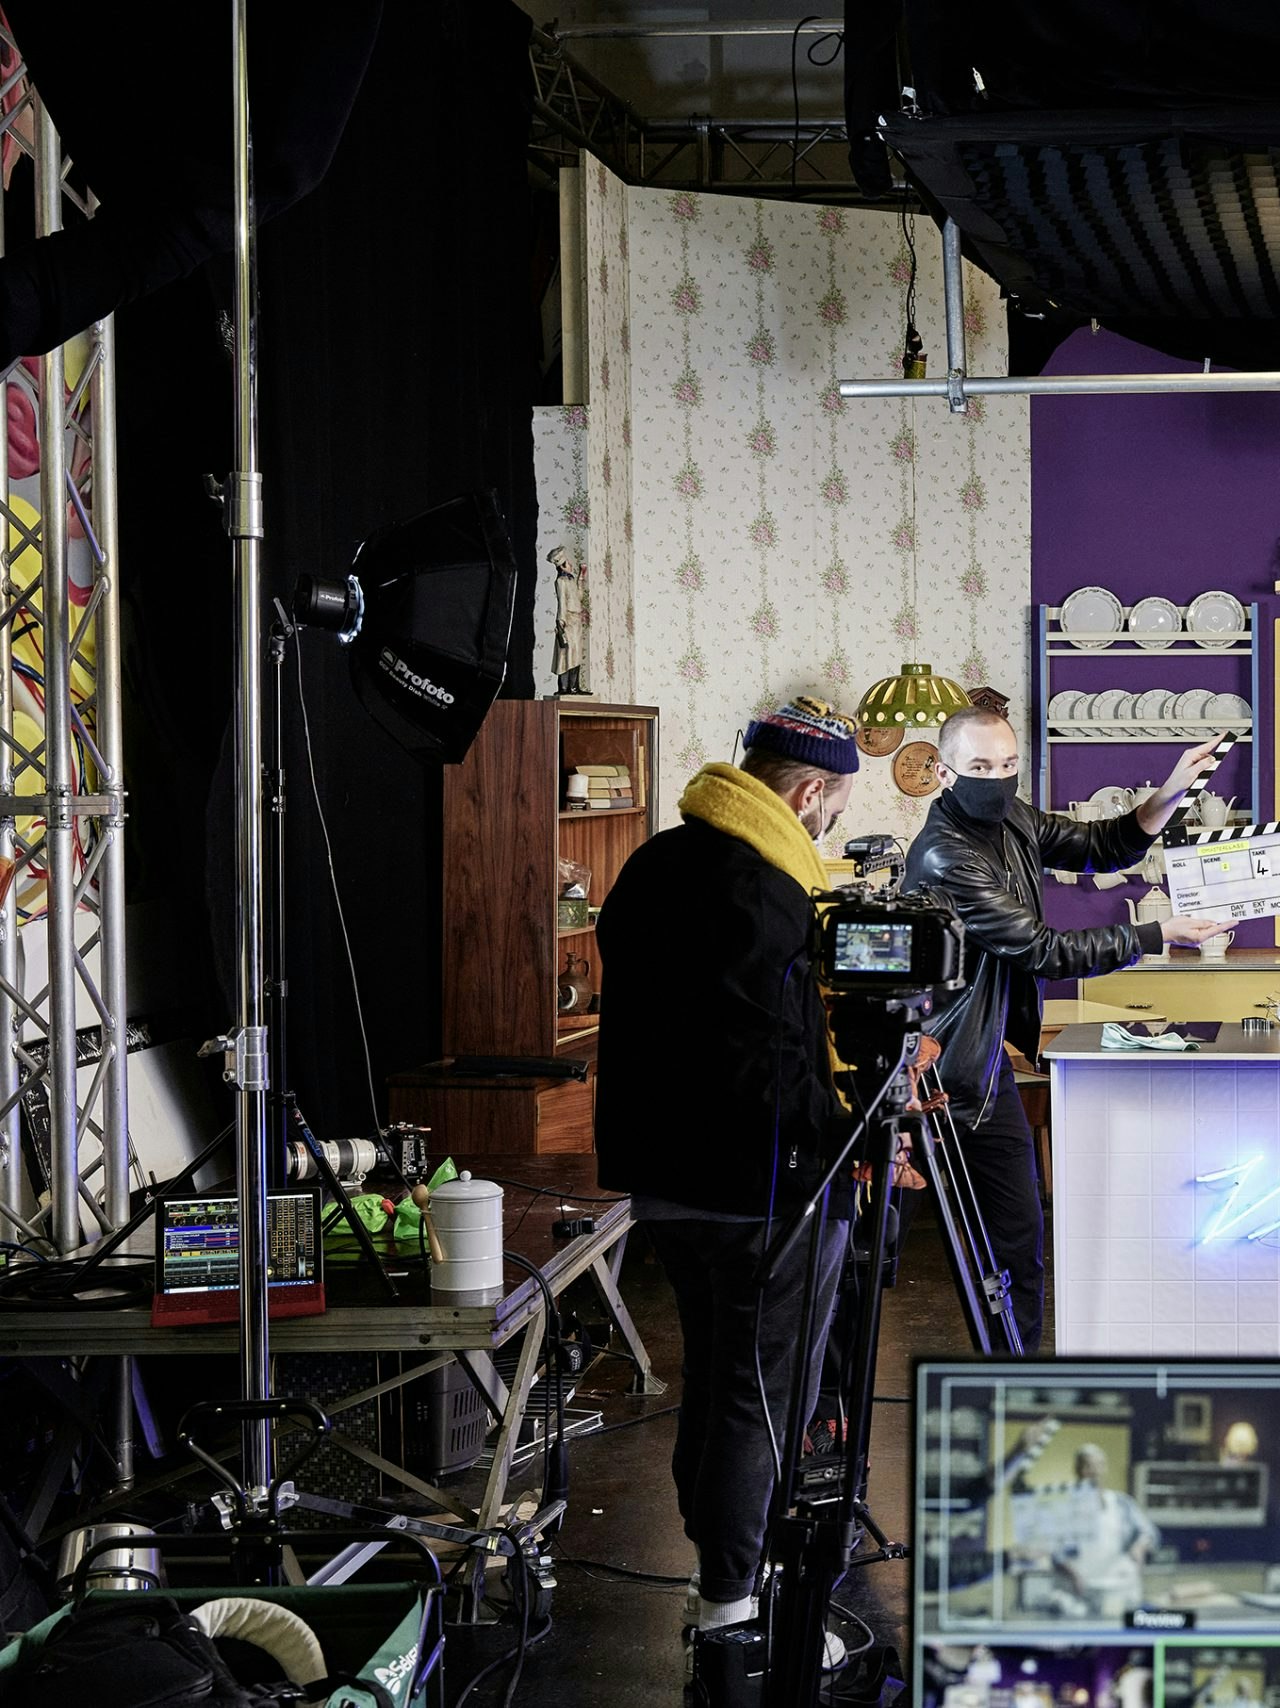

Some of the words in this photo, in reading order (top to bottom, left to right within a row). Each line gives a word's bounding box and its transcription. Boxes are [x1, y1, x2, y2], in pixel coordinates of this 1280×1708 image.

[395, 659, 455, 704] Profoto
[408, 685, 422, 697] Dish
[1257, 859, 1269, 875] 4
[1253, 900, 1266, 908] EXT
